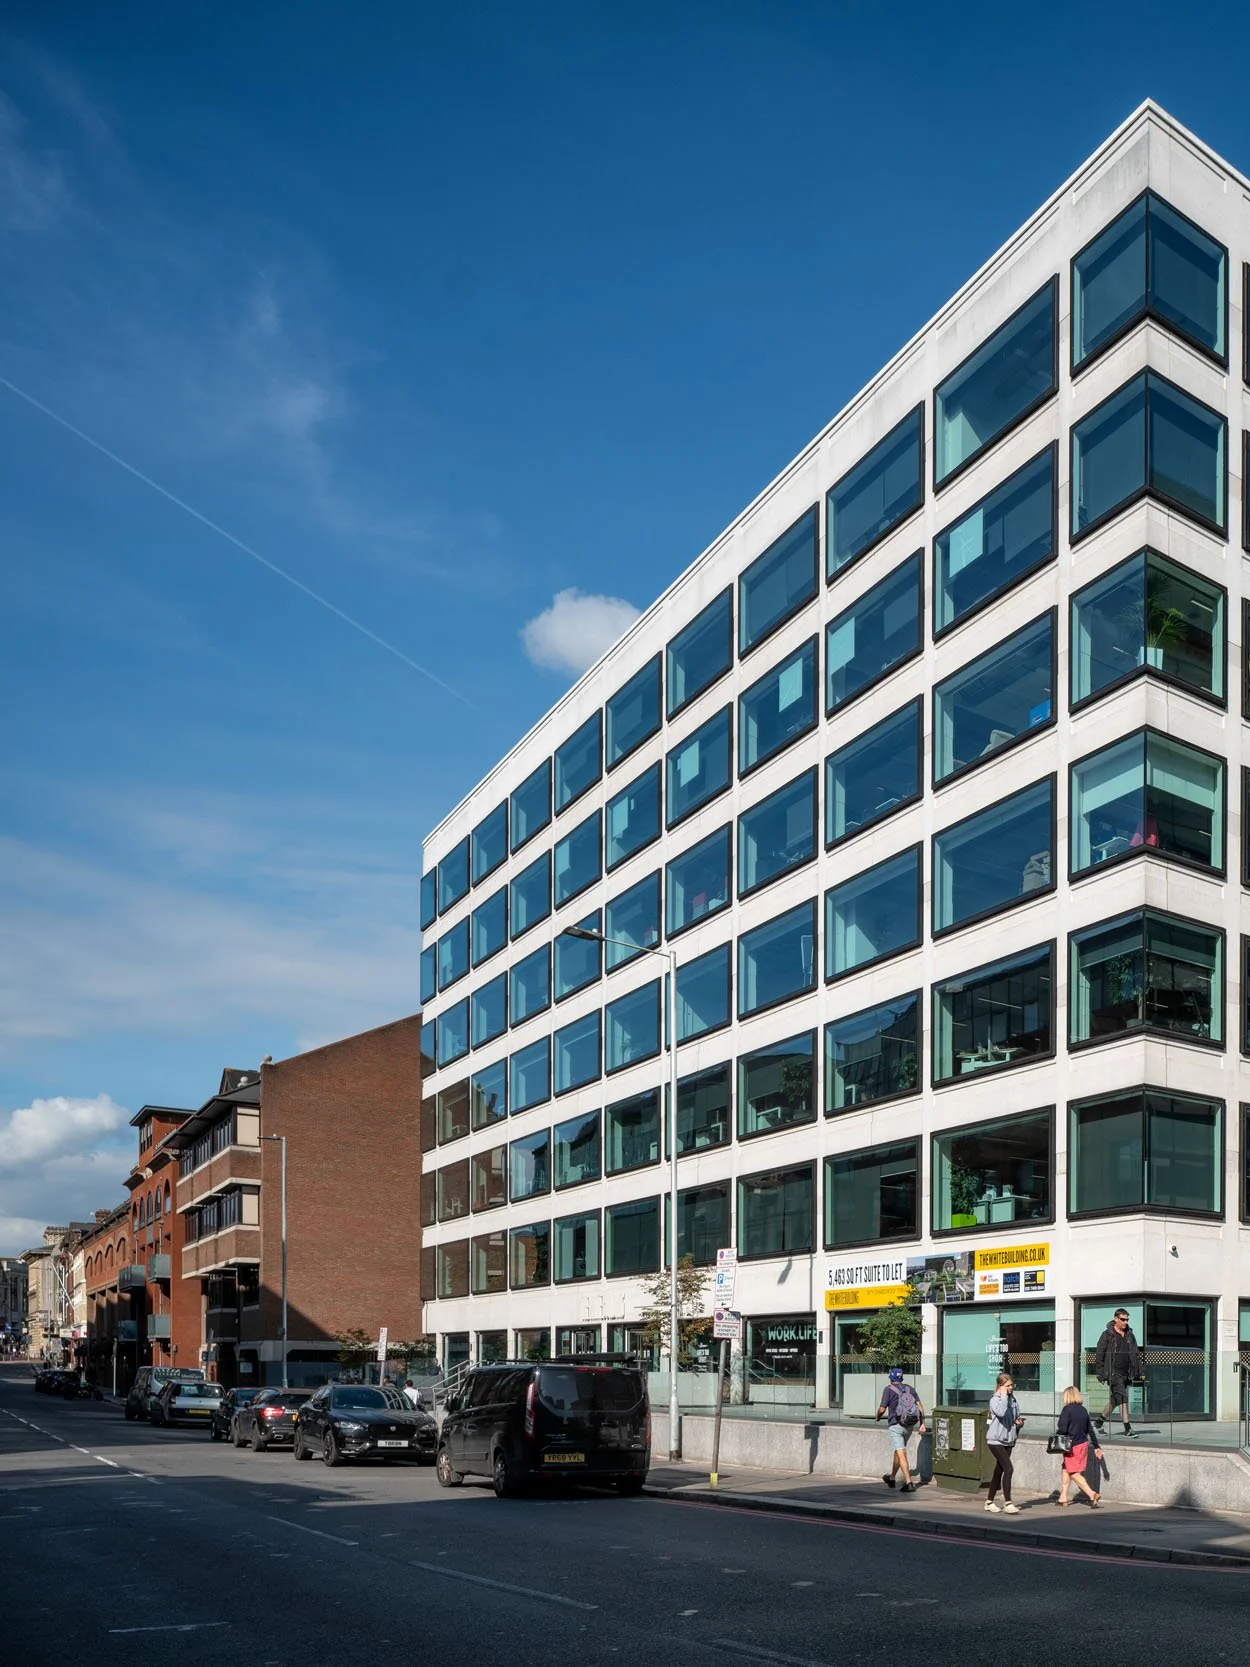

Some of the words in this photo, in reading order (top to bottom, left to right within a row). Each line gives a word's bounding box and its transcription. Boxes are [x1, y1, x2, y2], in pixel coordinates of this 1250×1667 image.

[979, 1248, 1046, 1266] THEWHITEBUILDING.CO.UK
[828, 1269, 846, 1287] 5,463
[846, 1267, 854, 1284] SQ
[855, 1266, 863, 1283] FT
[864, 1264, 881, 1282] SUITE
[882, 1263, 890, 1281] TO
[891, 1262, 903, 1280] LET
[768, 1325, 817, 1340] WORK.LIFE
